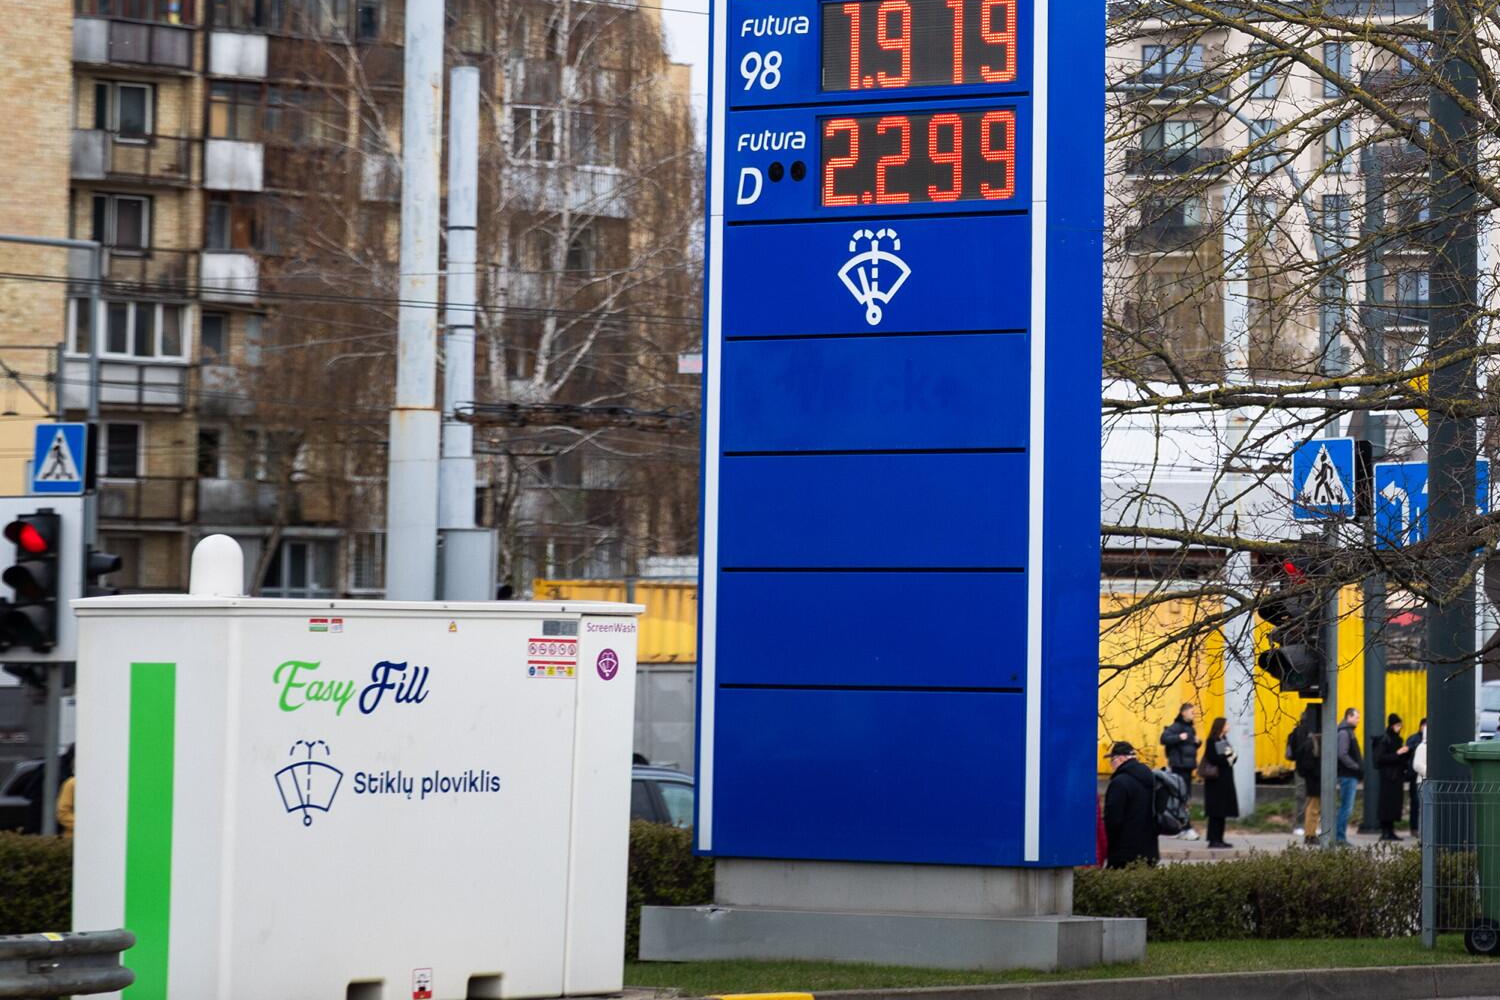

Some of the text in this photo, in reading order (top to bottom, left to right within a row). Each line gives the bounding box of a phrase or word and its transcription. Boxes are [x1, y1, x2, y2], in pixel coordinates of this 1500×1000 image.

[741, 15, 809, 38] Futura
[740, 50, 782, 90] 98
[737, 131, 806, 152] Futura
[822, 110, 1015, 207] 2.299
[736, 167, 763, 206] D
[586, 622, 636, 633] ScreenWash
[273, 661, 429, 716] Easy Fill
[353, 770, 501, 799] Stiklų ploviklis
